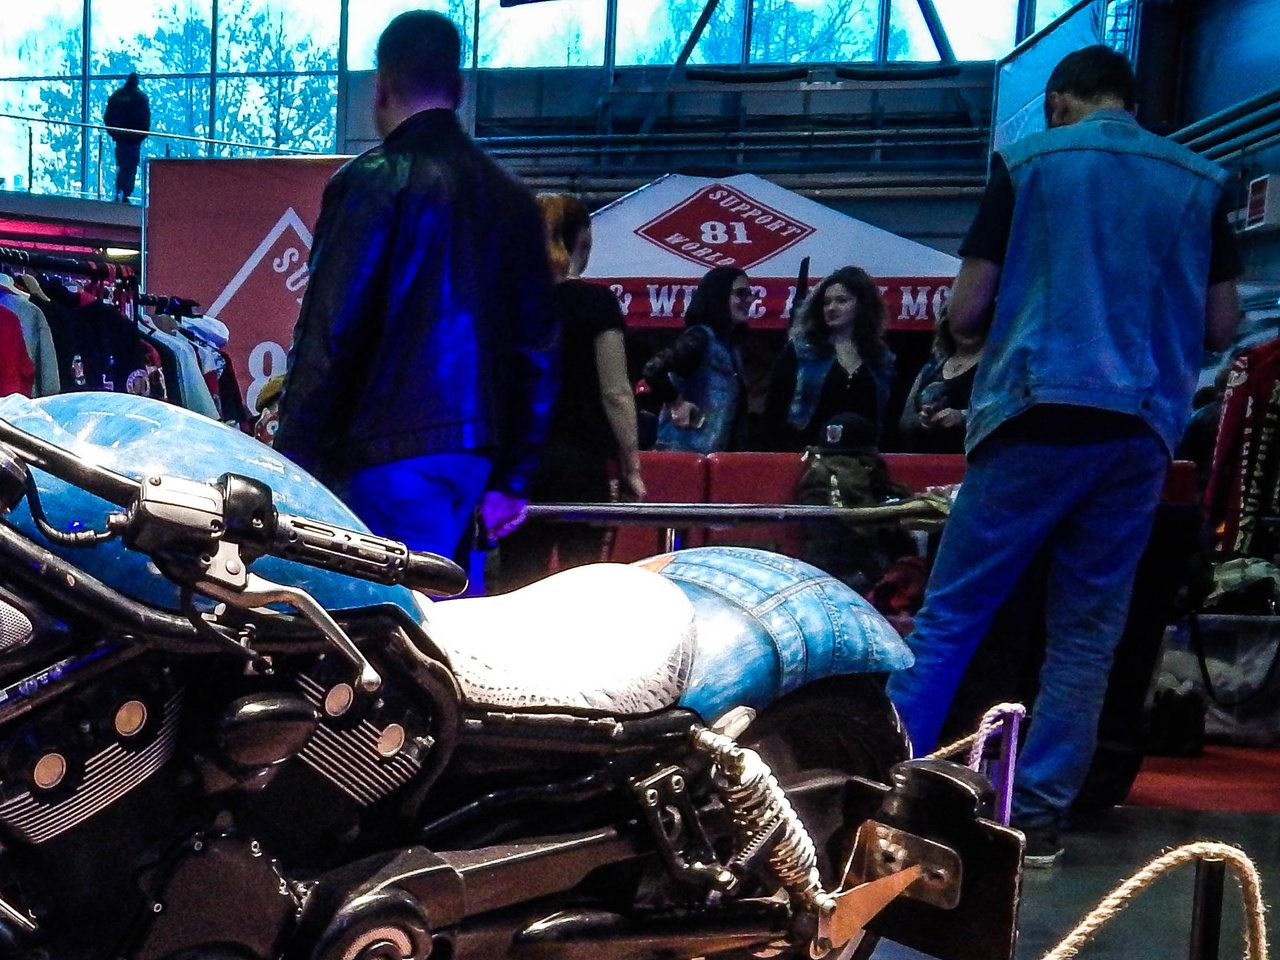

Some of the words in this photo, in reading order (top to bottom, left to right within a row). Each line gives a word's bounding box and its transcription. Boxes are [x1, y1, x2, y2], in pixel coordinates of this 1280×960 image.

[708, 190, 802, 237] SUPPORT
[664, 232, 737, 266] WORLD
[700, 221, 753, 244] 81
